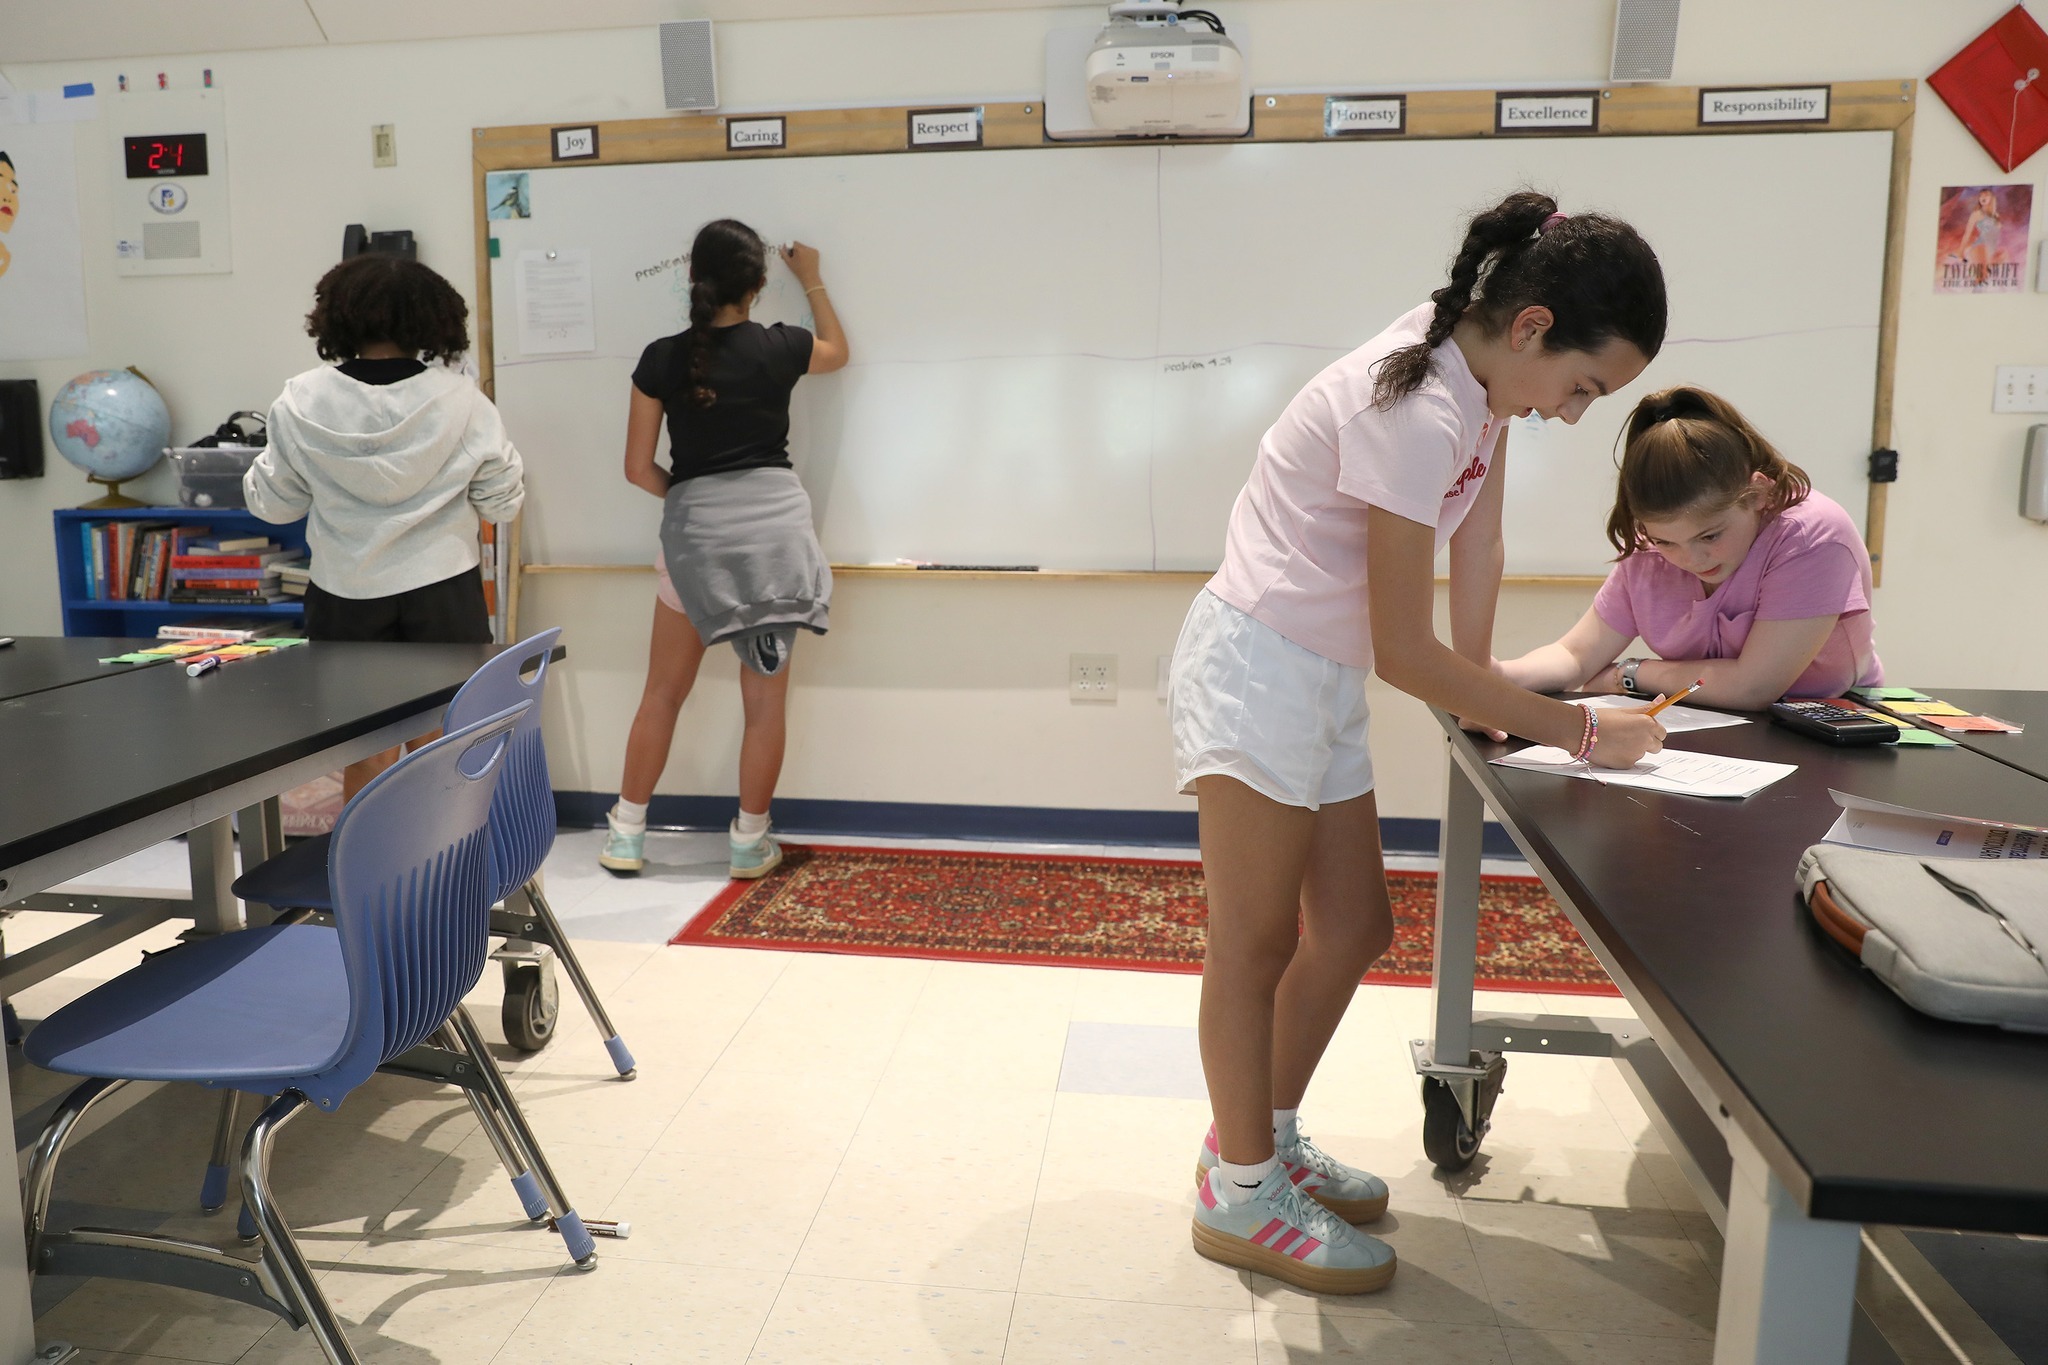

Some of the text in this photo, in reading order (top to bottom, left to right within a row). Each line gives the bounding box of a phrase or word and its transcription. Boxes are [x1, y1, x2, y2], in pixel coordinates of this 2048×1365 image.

[1508, 106, 1588, 120] Excellence
[1713, 98, 1817, 115] Responsibility
[1336, 107, 1397, 123] Honesty
[734, 129, 779, 144] Caring
[917, 122, 969, 137] Respect
[565, 135, 587, 151] Joy
[1943, 262, 2019, 279] TAYLOR SWIFT
[1992, 279, 2018, 287] TOUR
